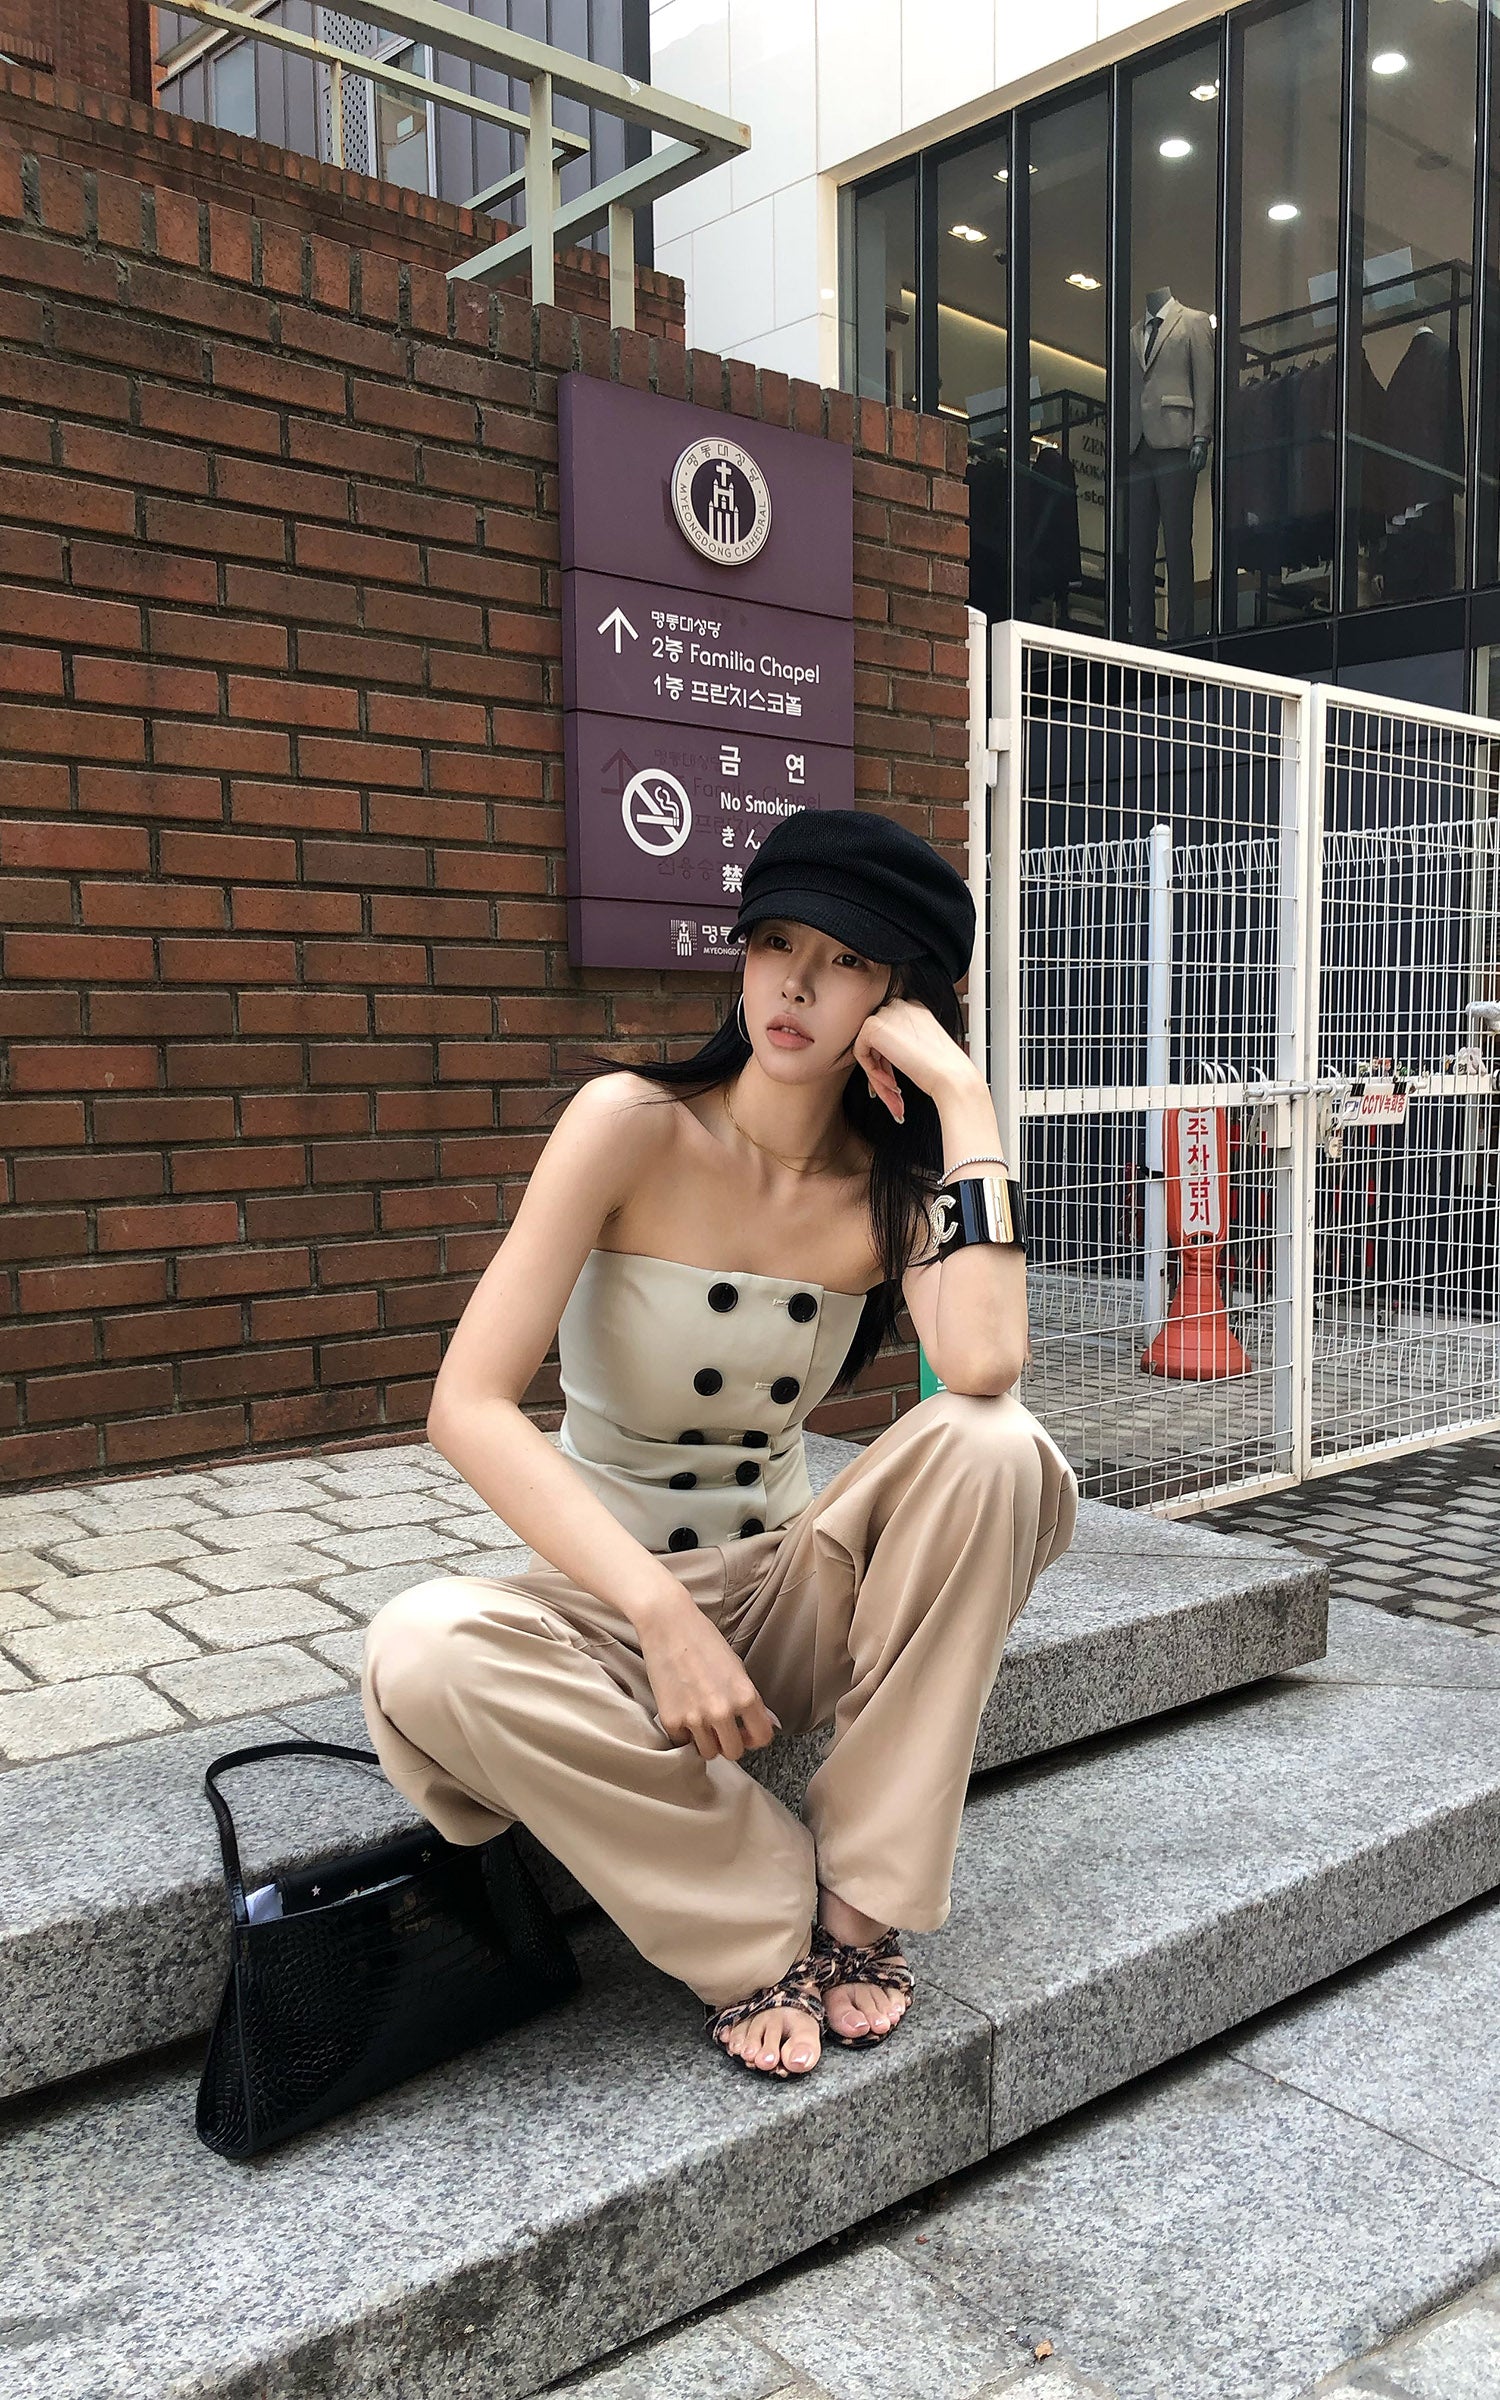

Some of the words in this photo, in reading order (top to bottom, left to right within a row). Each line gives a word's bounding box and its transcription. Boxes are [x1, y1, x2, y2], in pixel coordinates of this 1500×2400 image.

[686, 443, 759, 482] 명동대성당
[680, 482, 732, 558] MYEONGDONG
[734, 501, 766, 557] CATHEDRAL
[651, 611, 722, 639] 명동대성당
[651, 636, 684, 663] 2층
[690, 643, 755, 673] Familia
[759, 656, 820, 685] Chapel
[653, 673, 684, 700] 1층
[691, 680, 802, 717] 프란치스코홀
[720, 791, 741, 811] No
[1186, 1118, 1211, 1226] 주차금지
